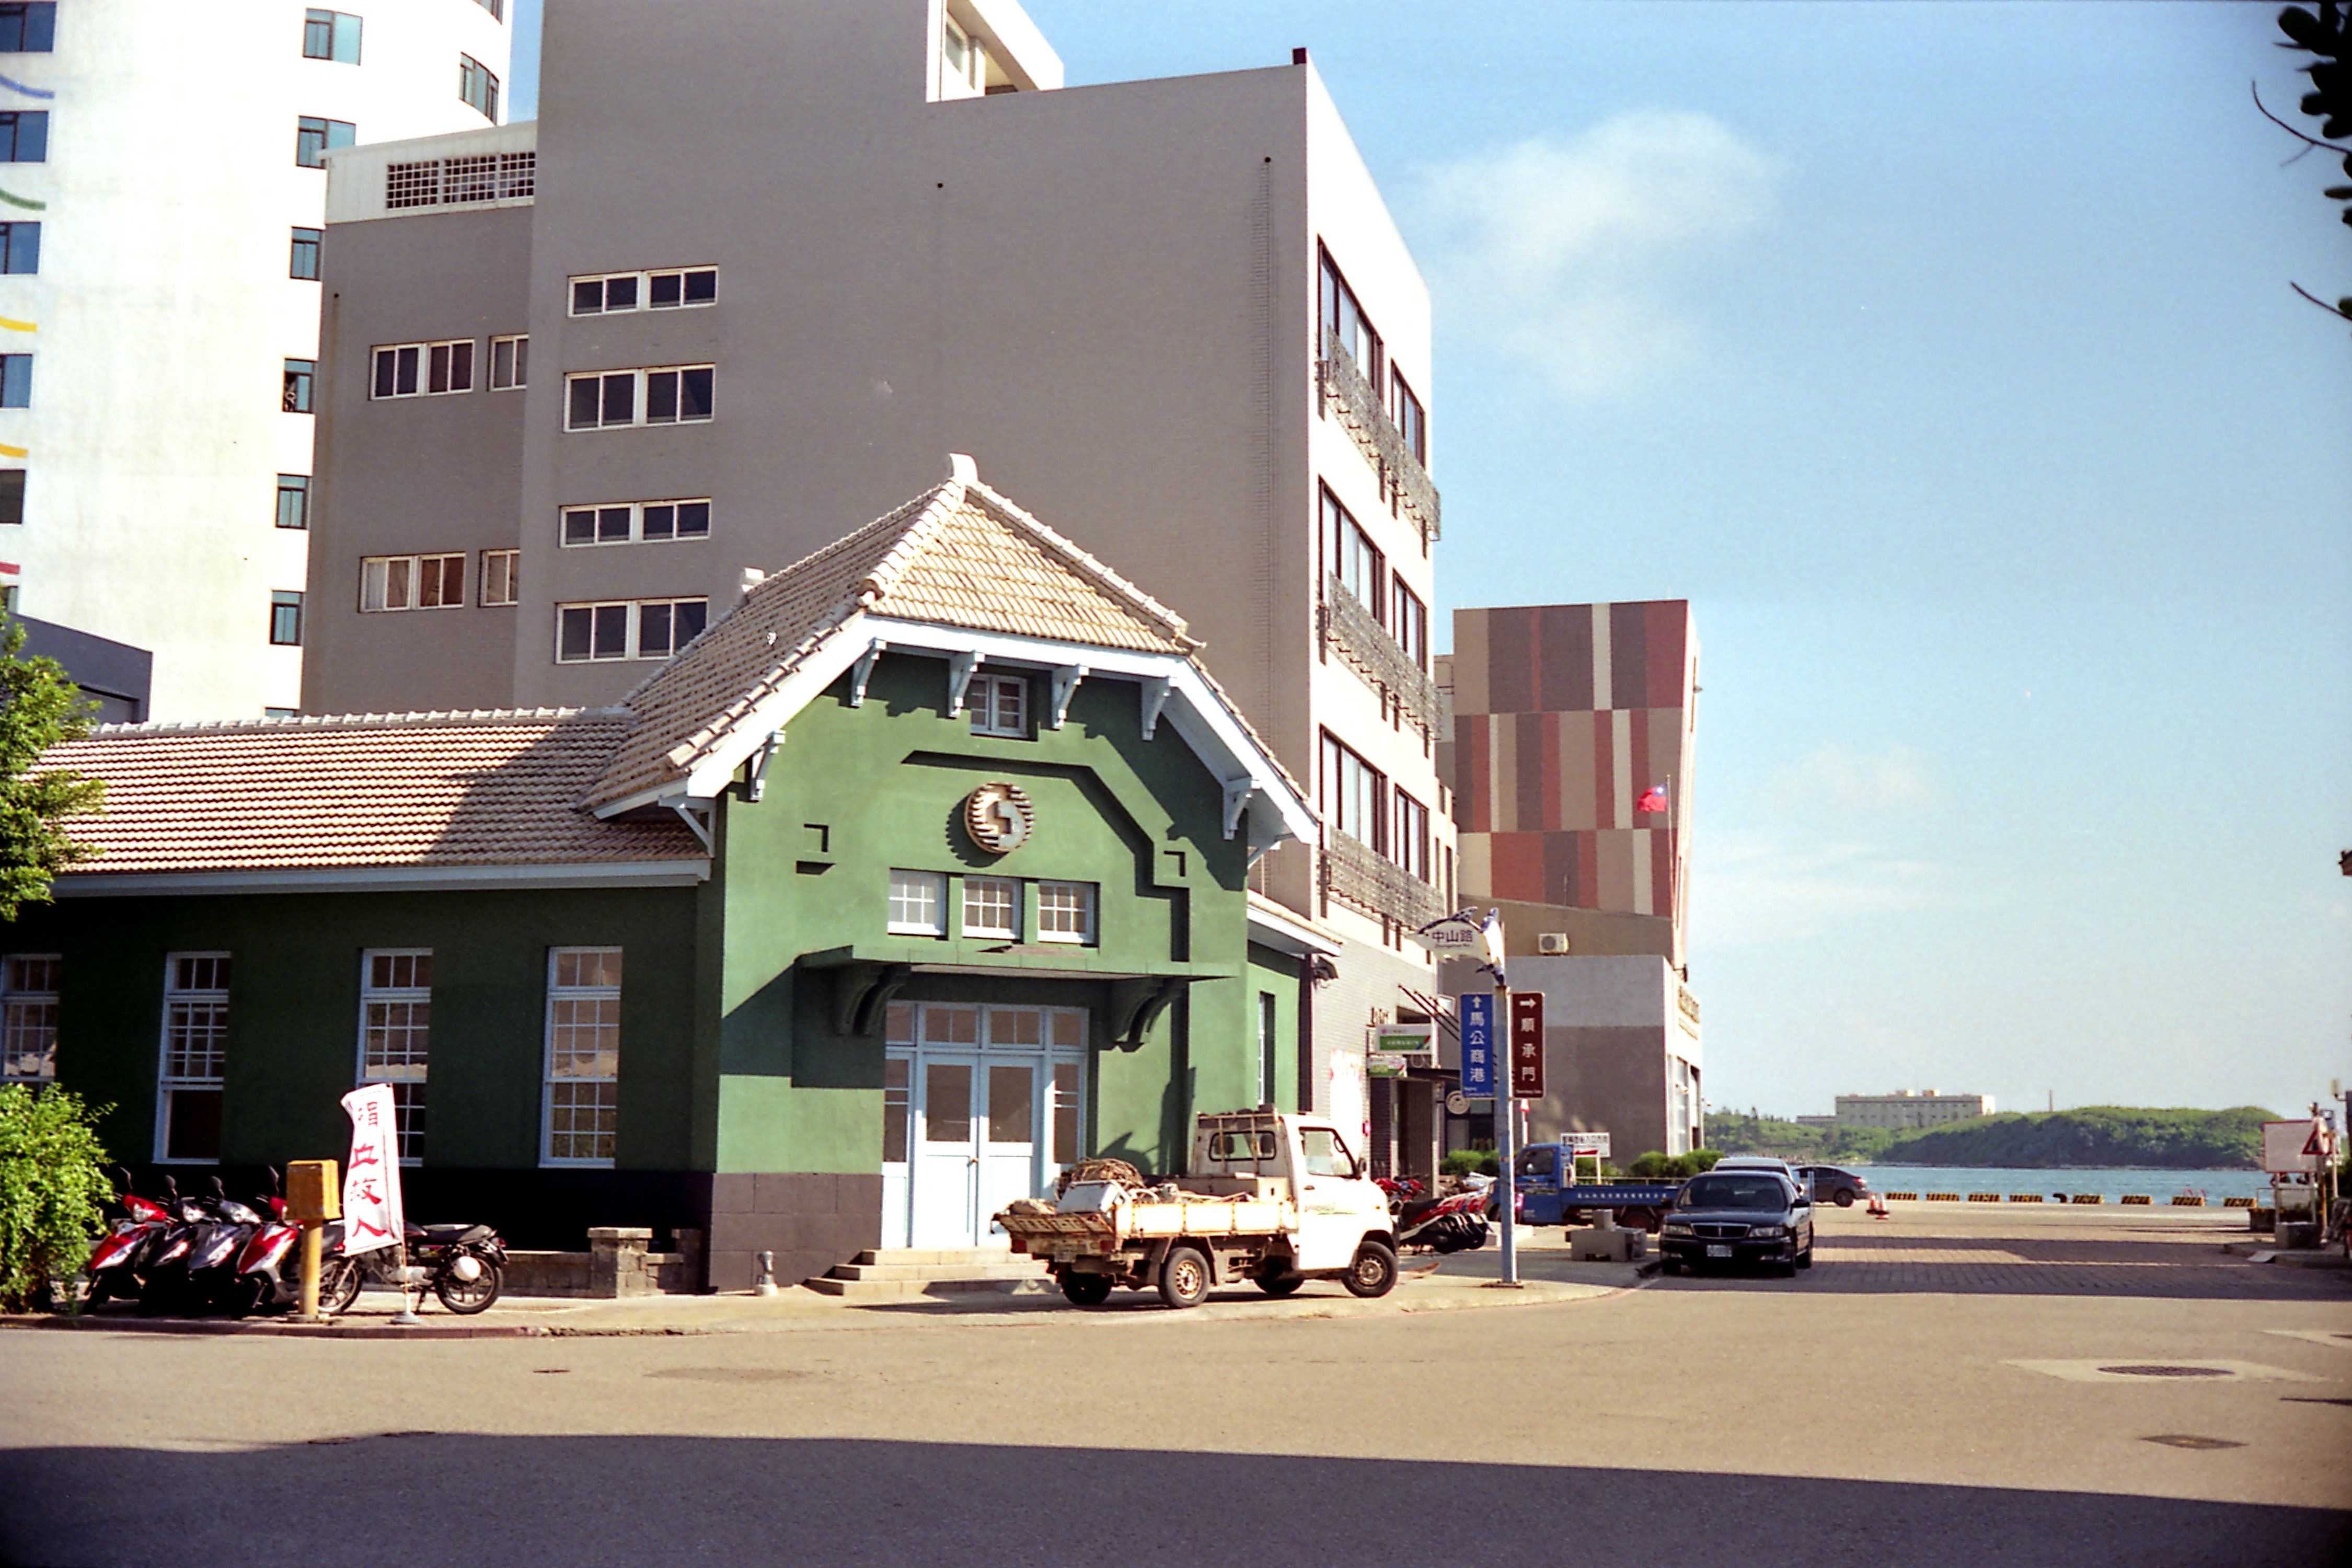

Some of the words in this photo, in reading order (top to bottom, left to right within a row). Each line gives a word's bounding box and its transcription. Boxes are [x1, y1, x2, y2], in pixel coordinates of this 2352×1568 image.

[1432, 930, 1472, 942] 中山路
[1470, 1011, 1485, 1082] 馬公商港
[1521, 1017, 1536, 1082] 順承門
